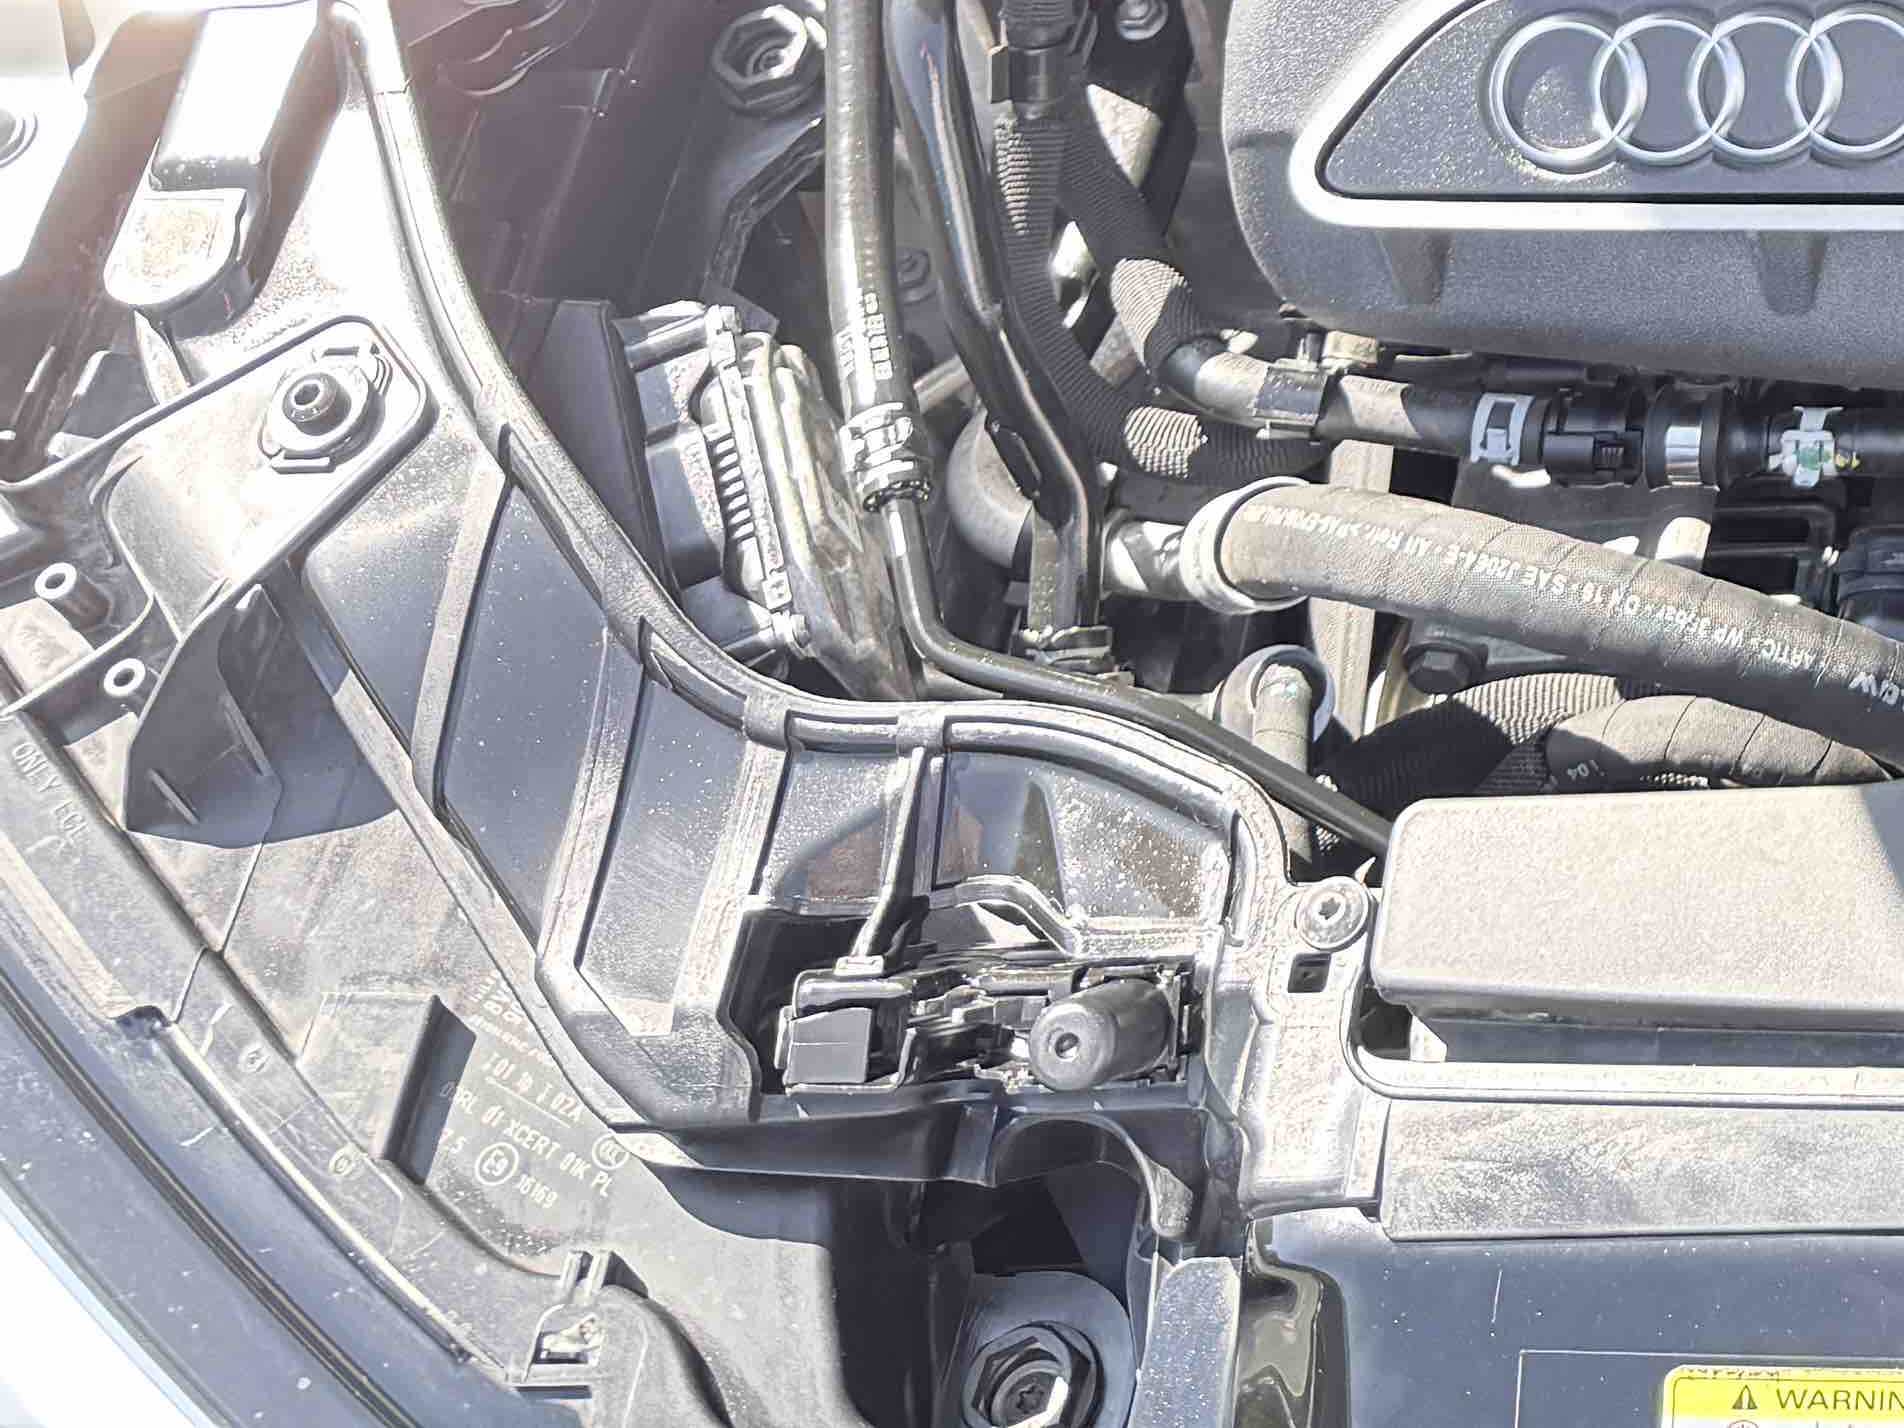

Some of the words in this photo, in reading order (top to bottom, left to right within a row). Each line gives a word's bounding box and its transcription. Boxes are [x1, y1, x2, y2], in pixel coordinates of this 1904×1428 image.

[1520, 563, 1569, 596] SAE
[551, 1091, 585, 1123] 02A
[590, 1170, 615, 1198] PL
